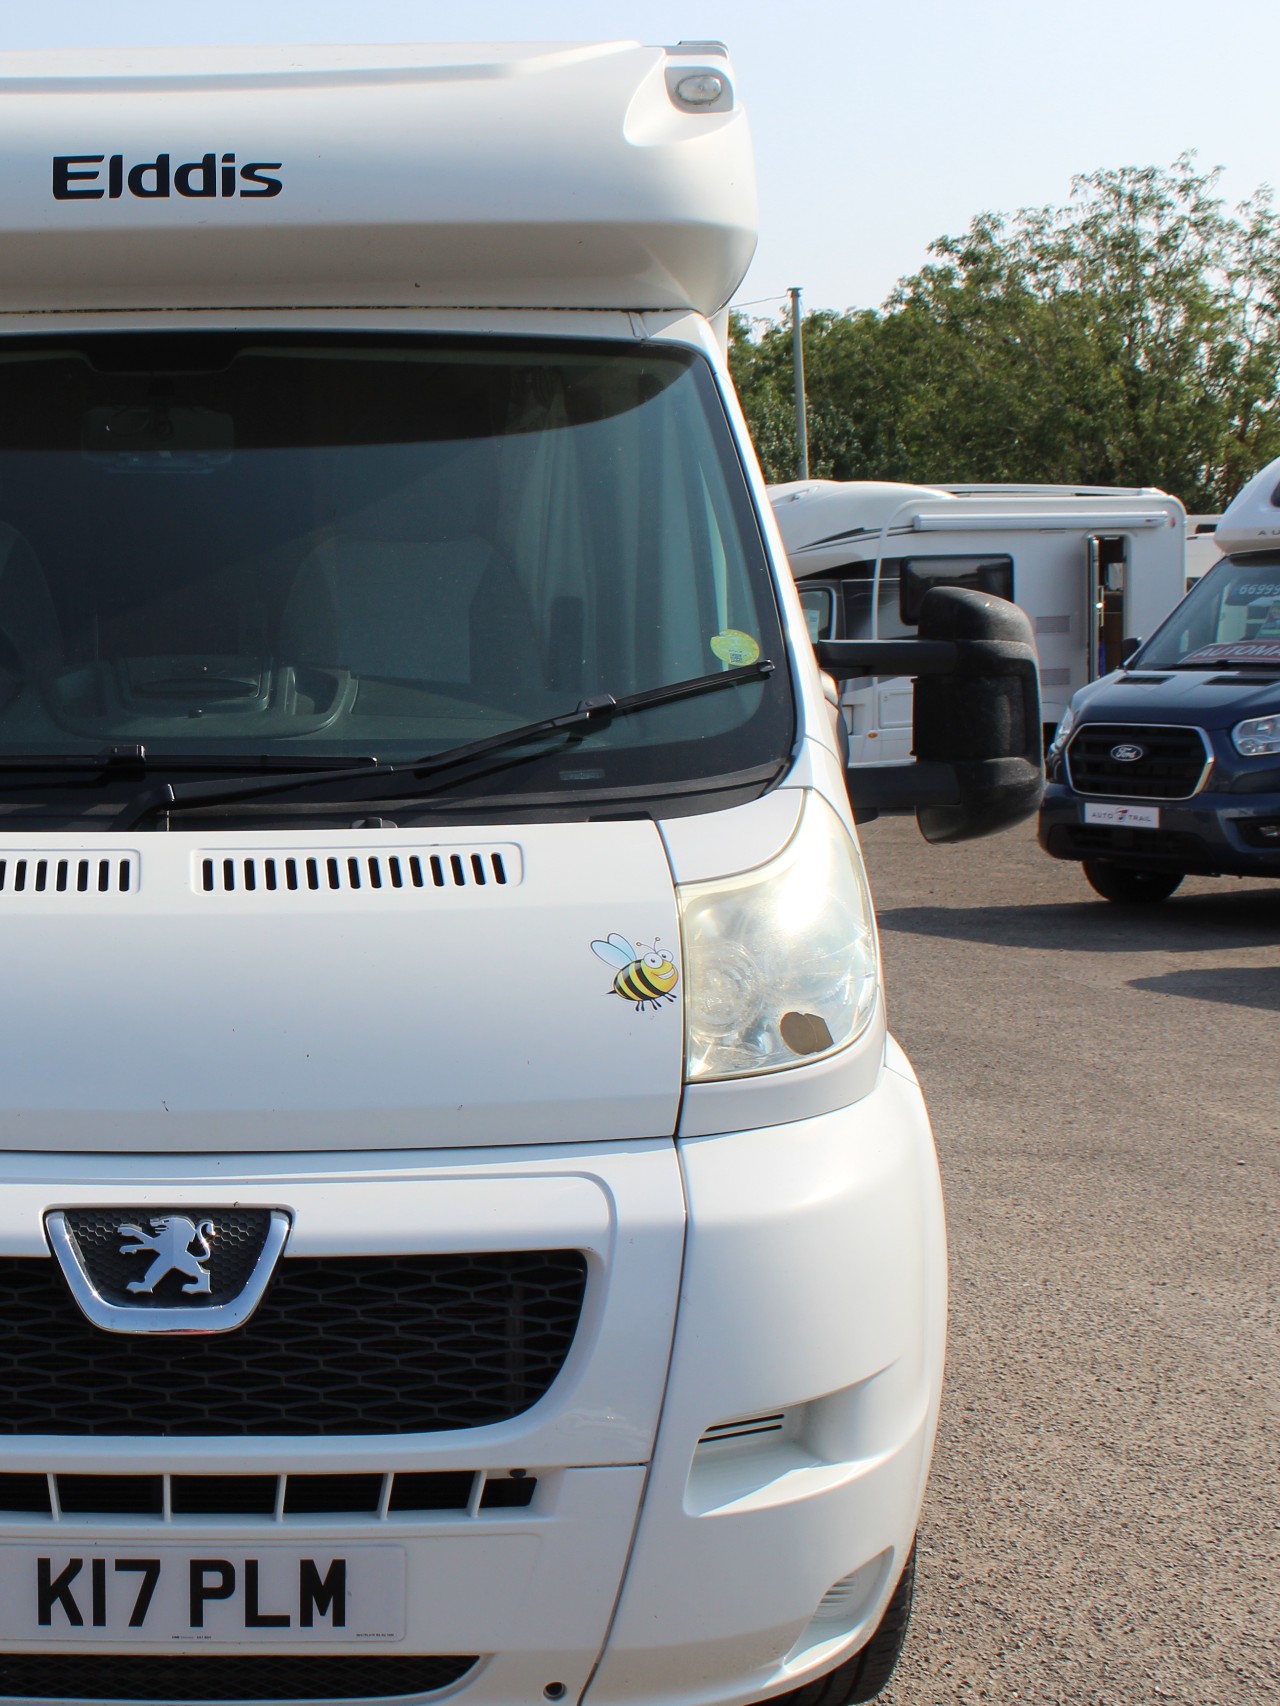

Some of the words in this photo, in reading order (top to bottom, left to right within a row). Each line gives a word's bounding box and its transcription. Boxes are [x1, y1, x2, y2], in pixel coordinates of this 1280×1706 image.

[53, 153, 283, 200] Elddis
[1114, 746, 1138, 759] Ford
[1128, 814, 1152, 822] TRAIL
[36, 1557, 161, 1627] K17
[189, 1558, 347, 1628] PLM
